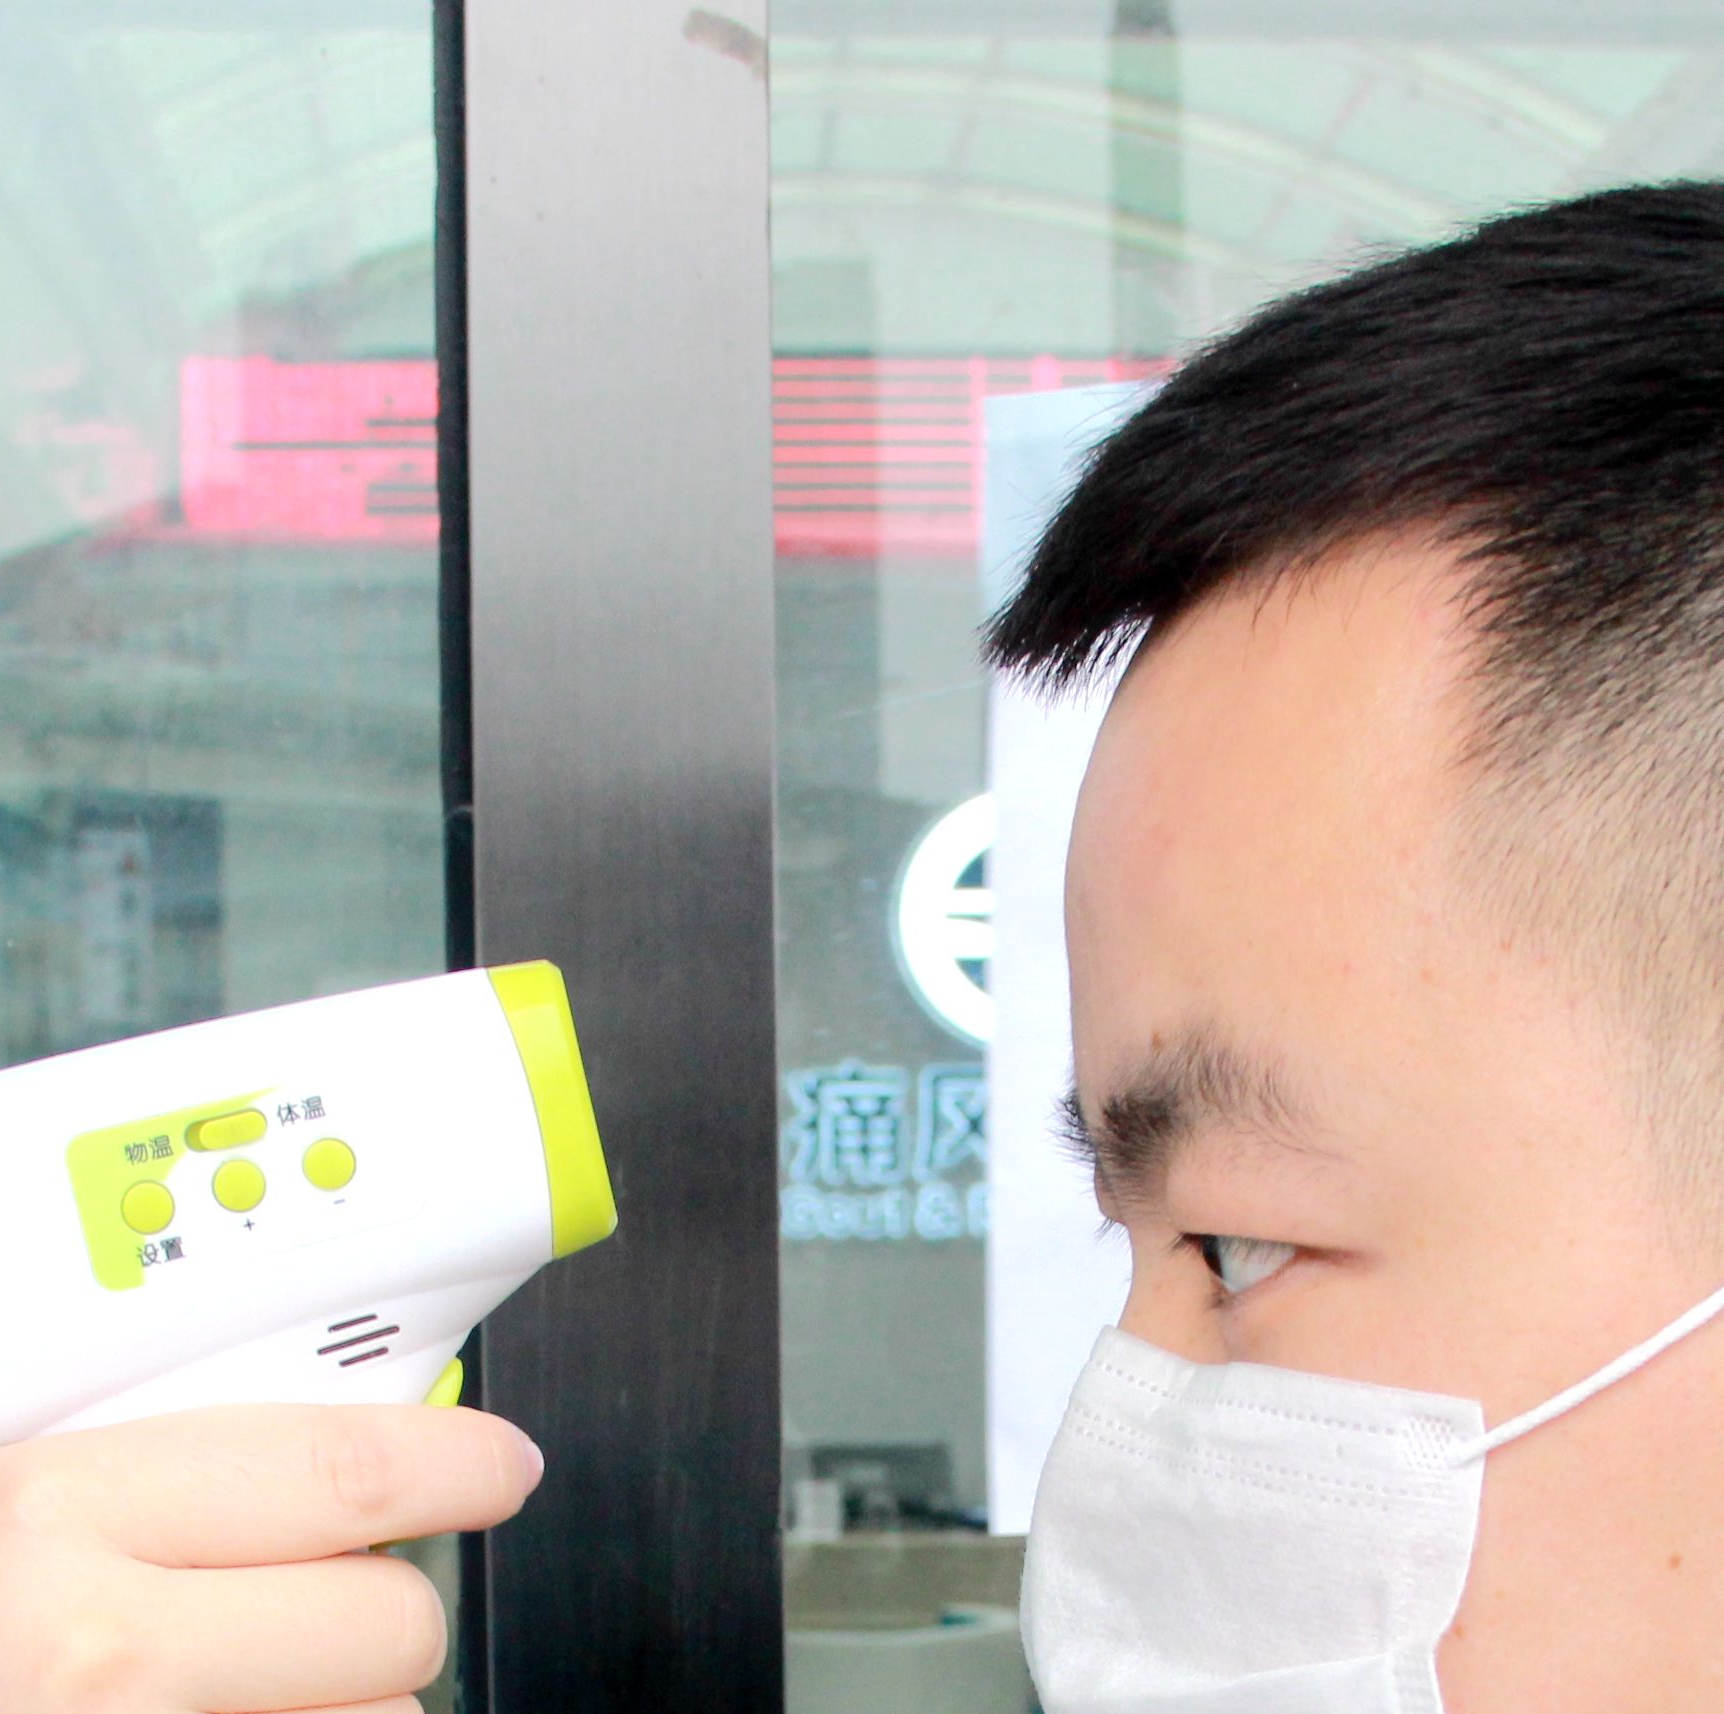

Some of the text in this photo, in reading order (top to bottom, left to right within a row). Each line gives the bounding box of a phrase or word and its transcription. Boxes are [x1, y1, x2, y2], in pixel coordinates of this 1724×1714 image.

[277, 1095, 327, 1127] 体温
[124, 1134, 174, 1165] 物温
[136, 1236, 186, 1268] 设置
